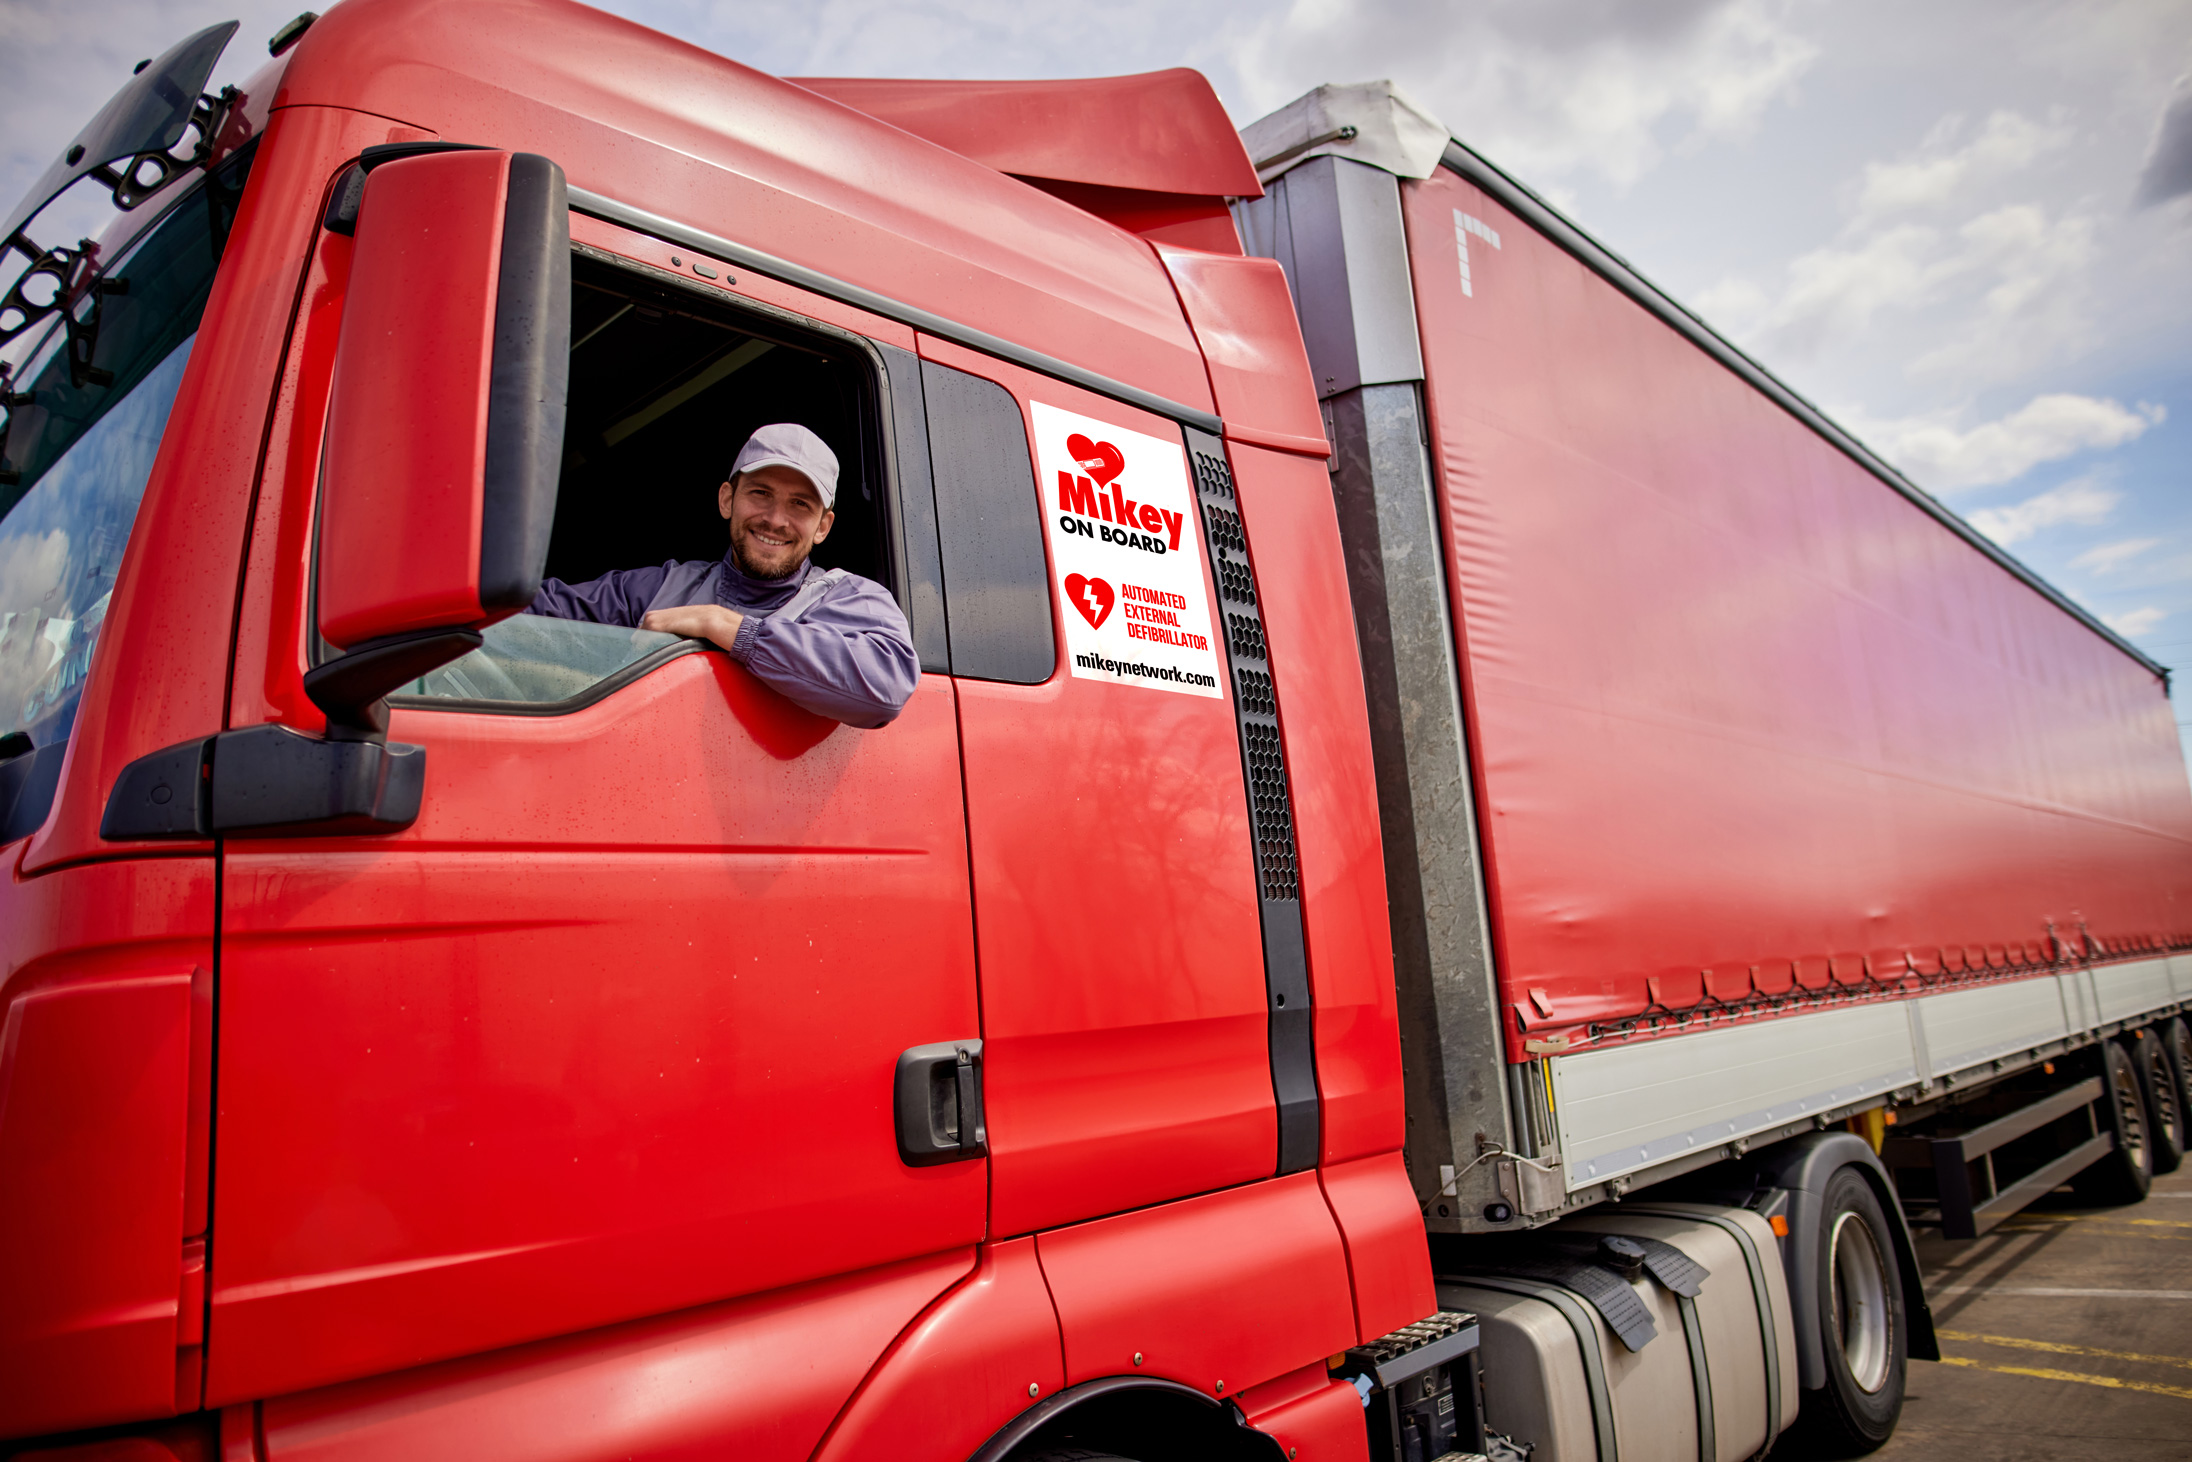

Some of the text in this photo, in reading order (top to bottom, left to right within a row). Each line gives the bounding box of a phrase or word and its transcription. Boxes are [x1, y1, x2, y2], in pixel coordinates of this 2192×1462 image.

[1058, 470, 1184, 552] Mikey
[1059, 515, 1167, 555] ON BOARD
[1121, 583, 1187, 611] AUTOMATED
[1123, 602, 1181, 628] EXTERNAL
[1126, 622, 1209, 652] DEFIBRILLATOR
[1076, 652, 1216, 688] mikeynetwork.com
